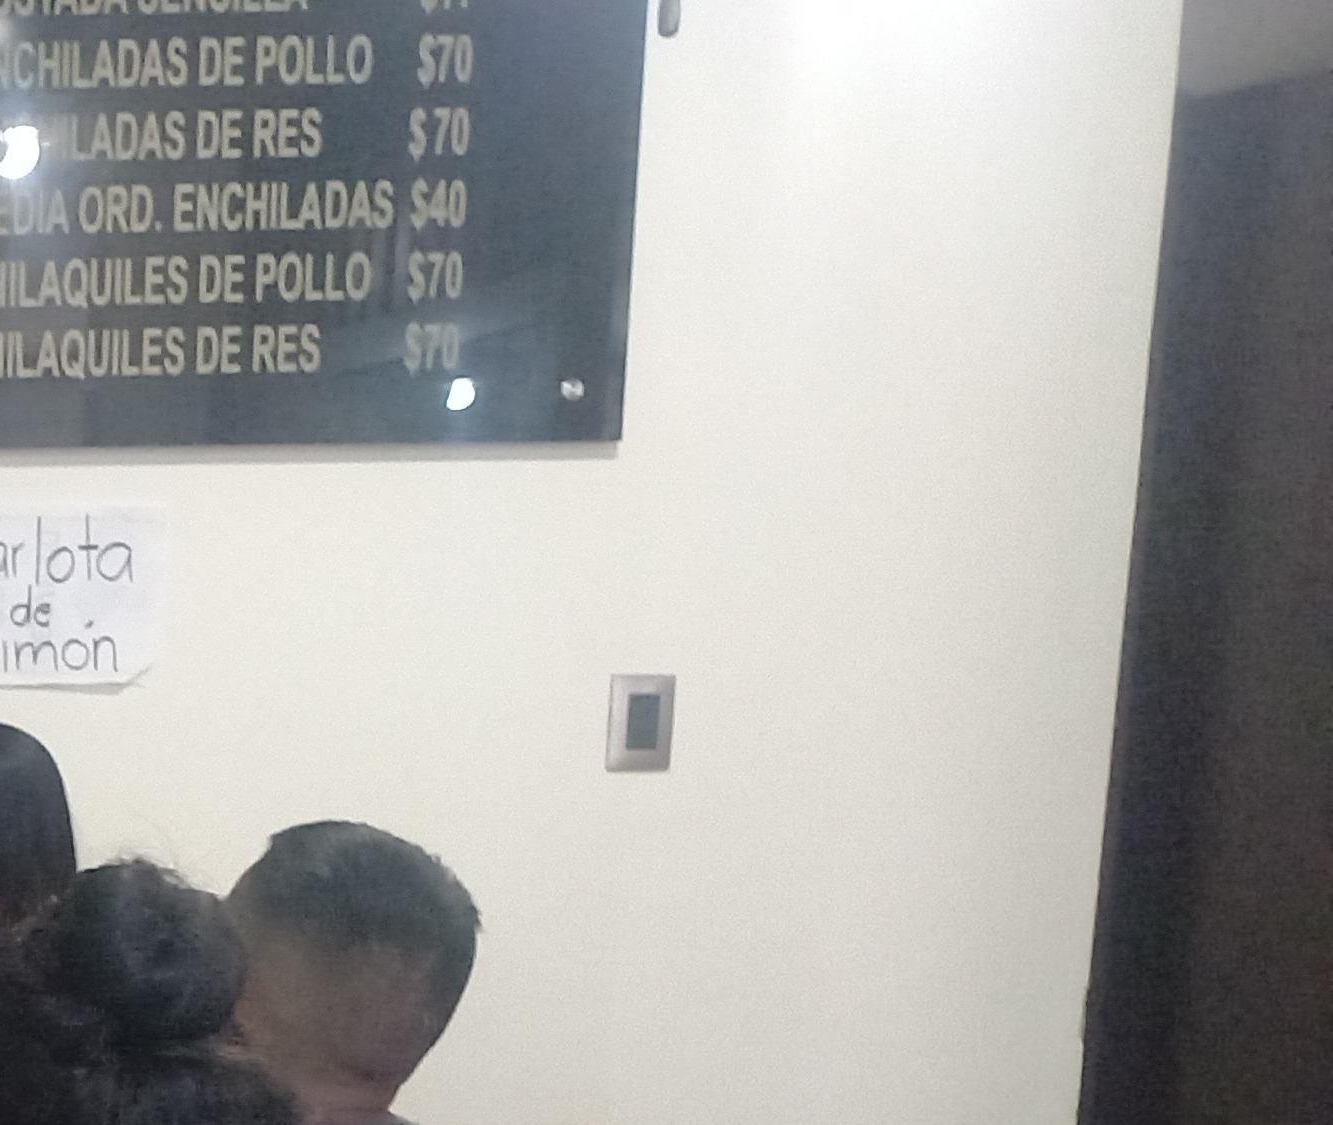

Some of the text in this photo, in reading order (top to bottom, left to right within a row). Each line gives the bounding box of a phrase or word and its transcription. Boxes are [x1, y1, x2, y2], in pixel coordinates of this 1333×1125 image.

[198, 35, 246, 87] DE
[255, 33, 373, 86] POLLO
[417, 33, 473, 89] $70
[196, 108, 244, 160] DE
[253, 107, 323, 159] RES
[79, 184, 163, 234] ORD.
[173, 179, 394, 233] ENCHILADAS
[410, 177, 467, 231] $40
[199, 254, 246, 303] DE
[255, 252, 372, 303] POLLO
[407, 251, 464, 304] $70
[195, 325, 242, 374] DE
[252, 323, 321, 374] RES
[404, 320, 459, 377] $70
[10, 584, 51, 627] de
